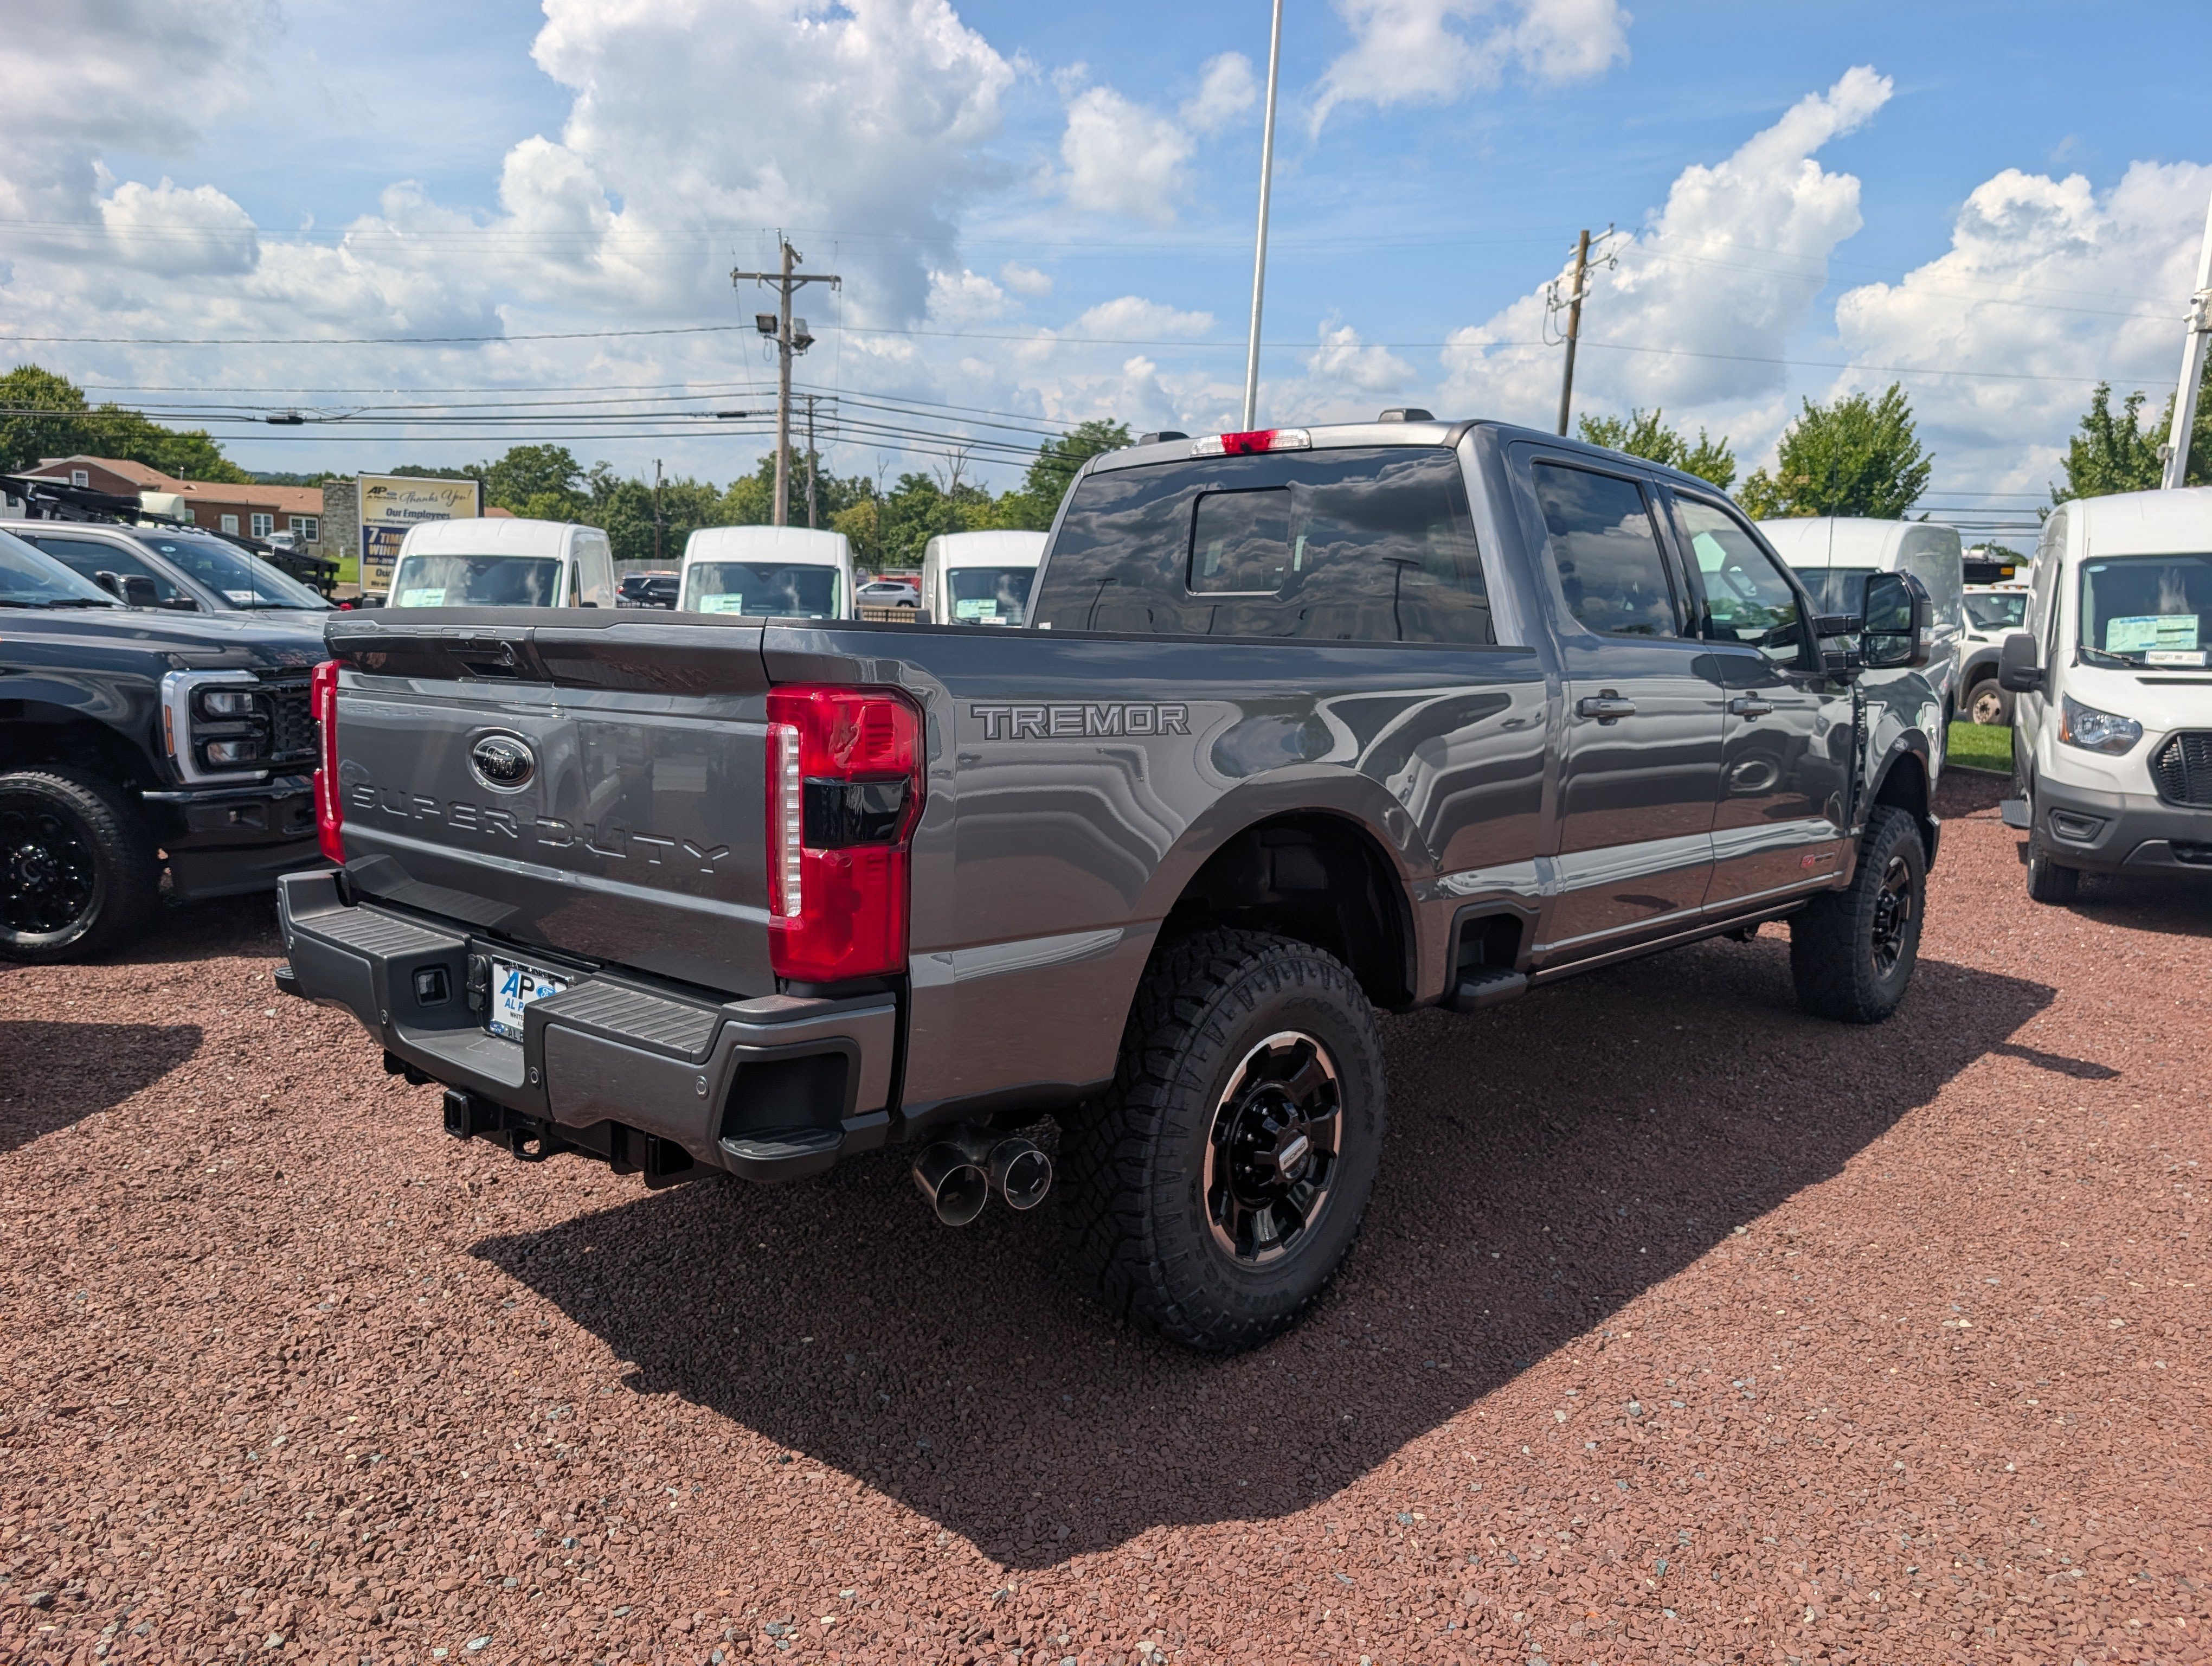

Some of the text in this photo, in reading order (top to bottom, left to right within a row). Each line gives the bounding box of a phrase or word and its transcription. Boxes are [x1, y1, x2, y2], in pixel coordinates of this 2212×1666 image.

[386, 507, 450, 520] Our Employees
[369, 527, 380, 543] 7
[369, 544, 399, 556] WINN
[376, 568, 391, 576] Our
[970, 703, 1192, 740] TREMOR
[484, 746, 516, 776] Ford
[351, 783, 730, 874] SUPER DUTY
[500, 971, 535, 999] AP
[505, 997, 515, 1010] AL
[508, 1027, 518, 1040] AL
[1283, 1143, 1306, 1165] FORD
